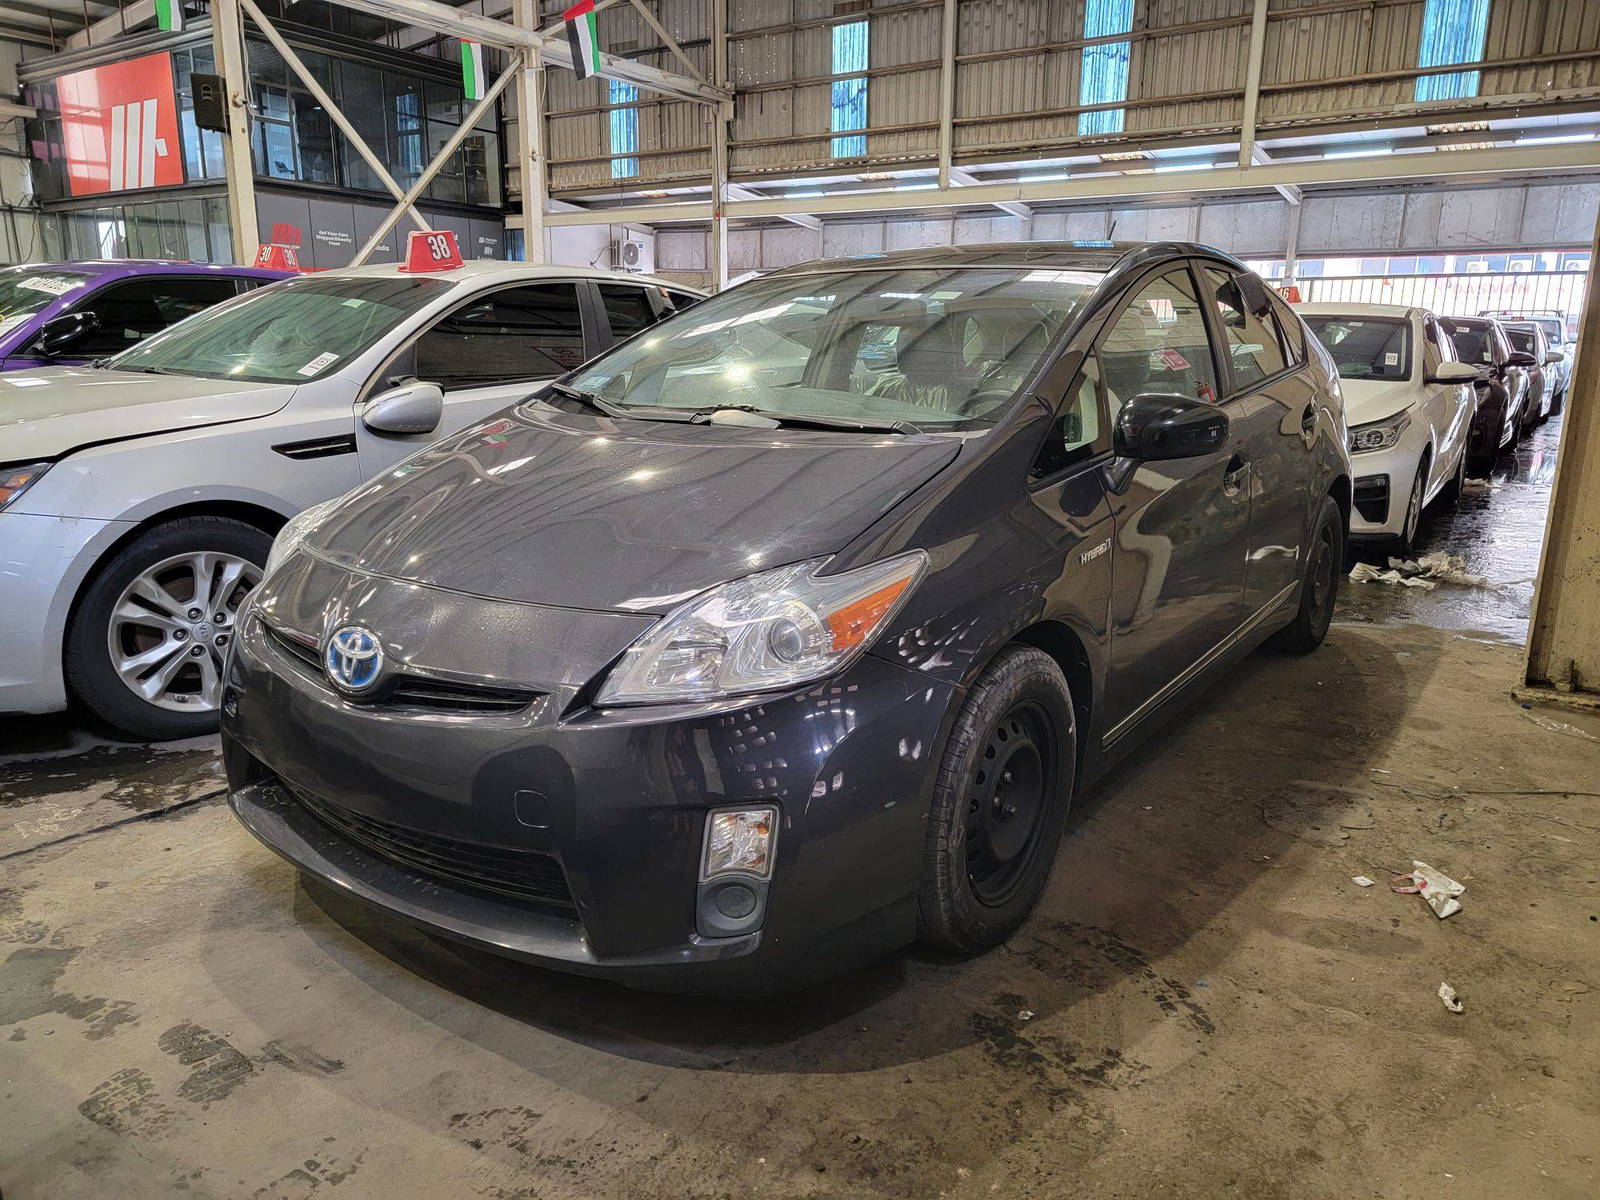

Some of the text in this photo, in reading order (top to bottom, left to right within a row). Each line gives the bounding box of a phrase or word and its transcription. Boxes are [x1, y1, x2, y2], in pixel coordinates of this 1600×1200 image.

[259, 246, 272, 262] 30
[427, 234, 451, 260] 38
[1081, 537, 1111, 566] HYBRID
